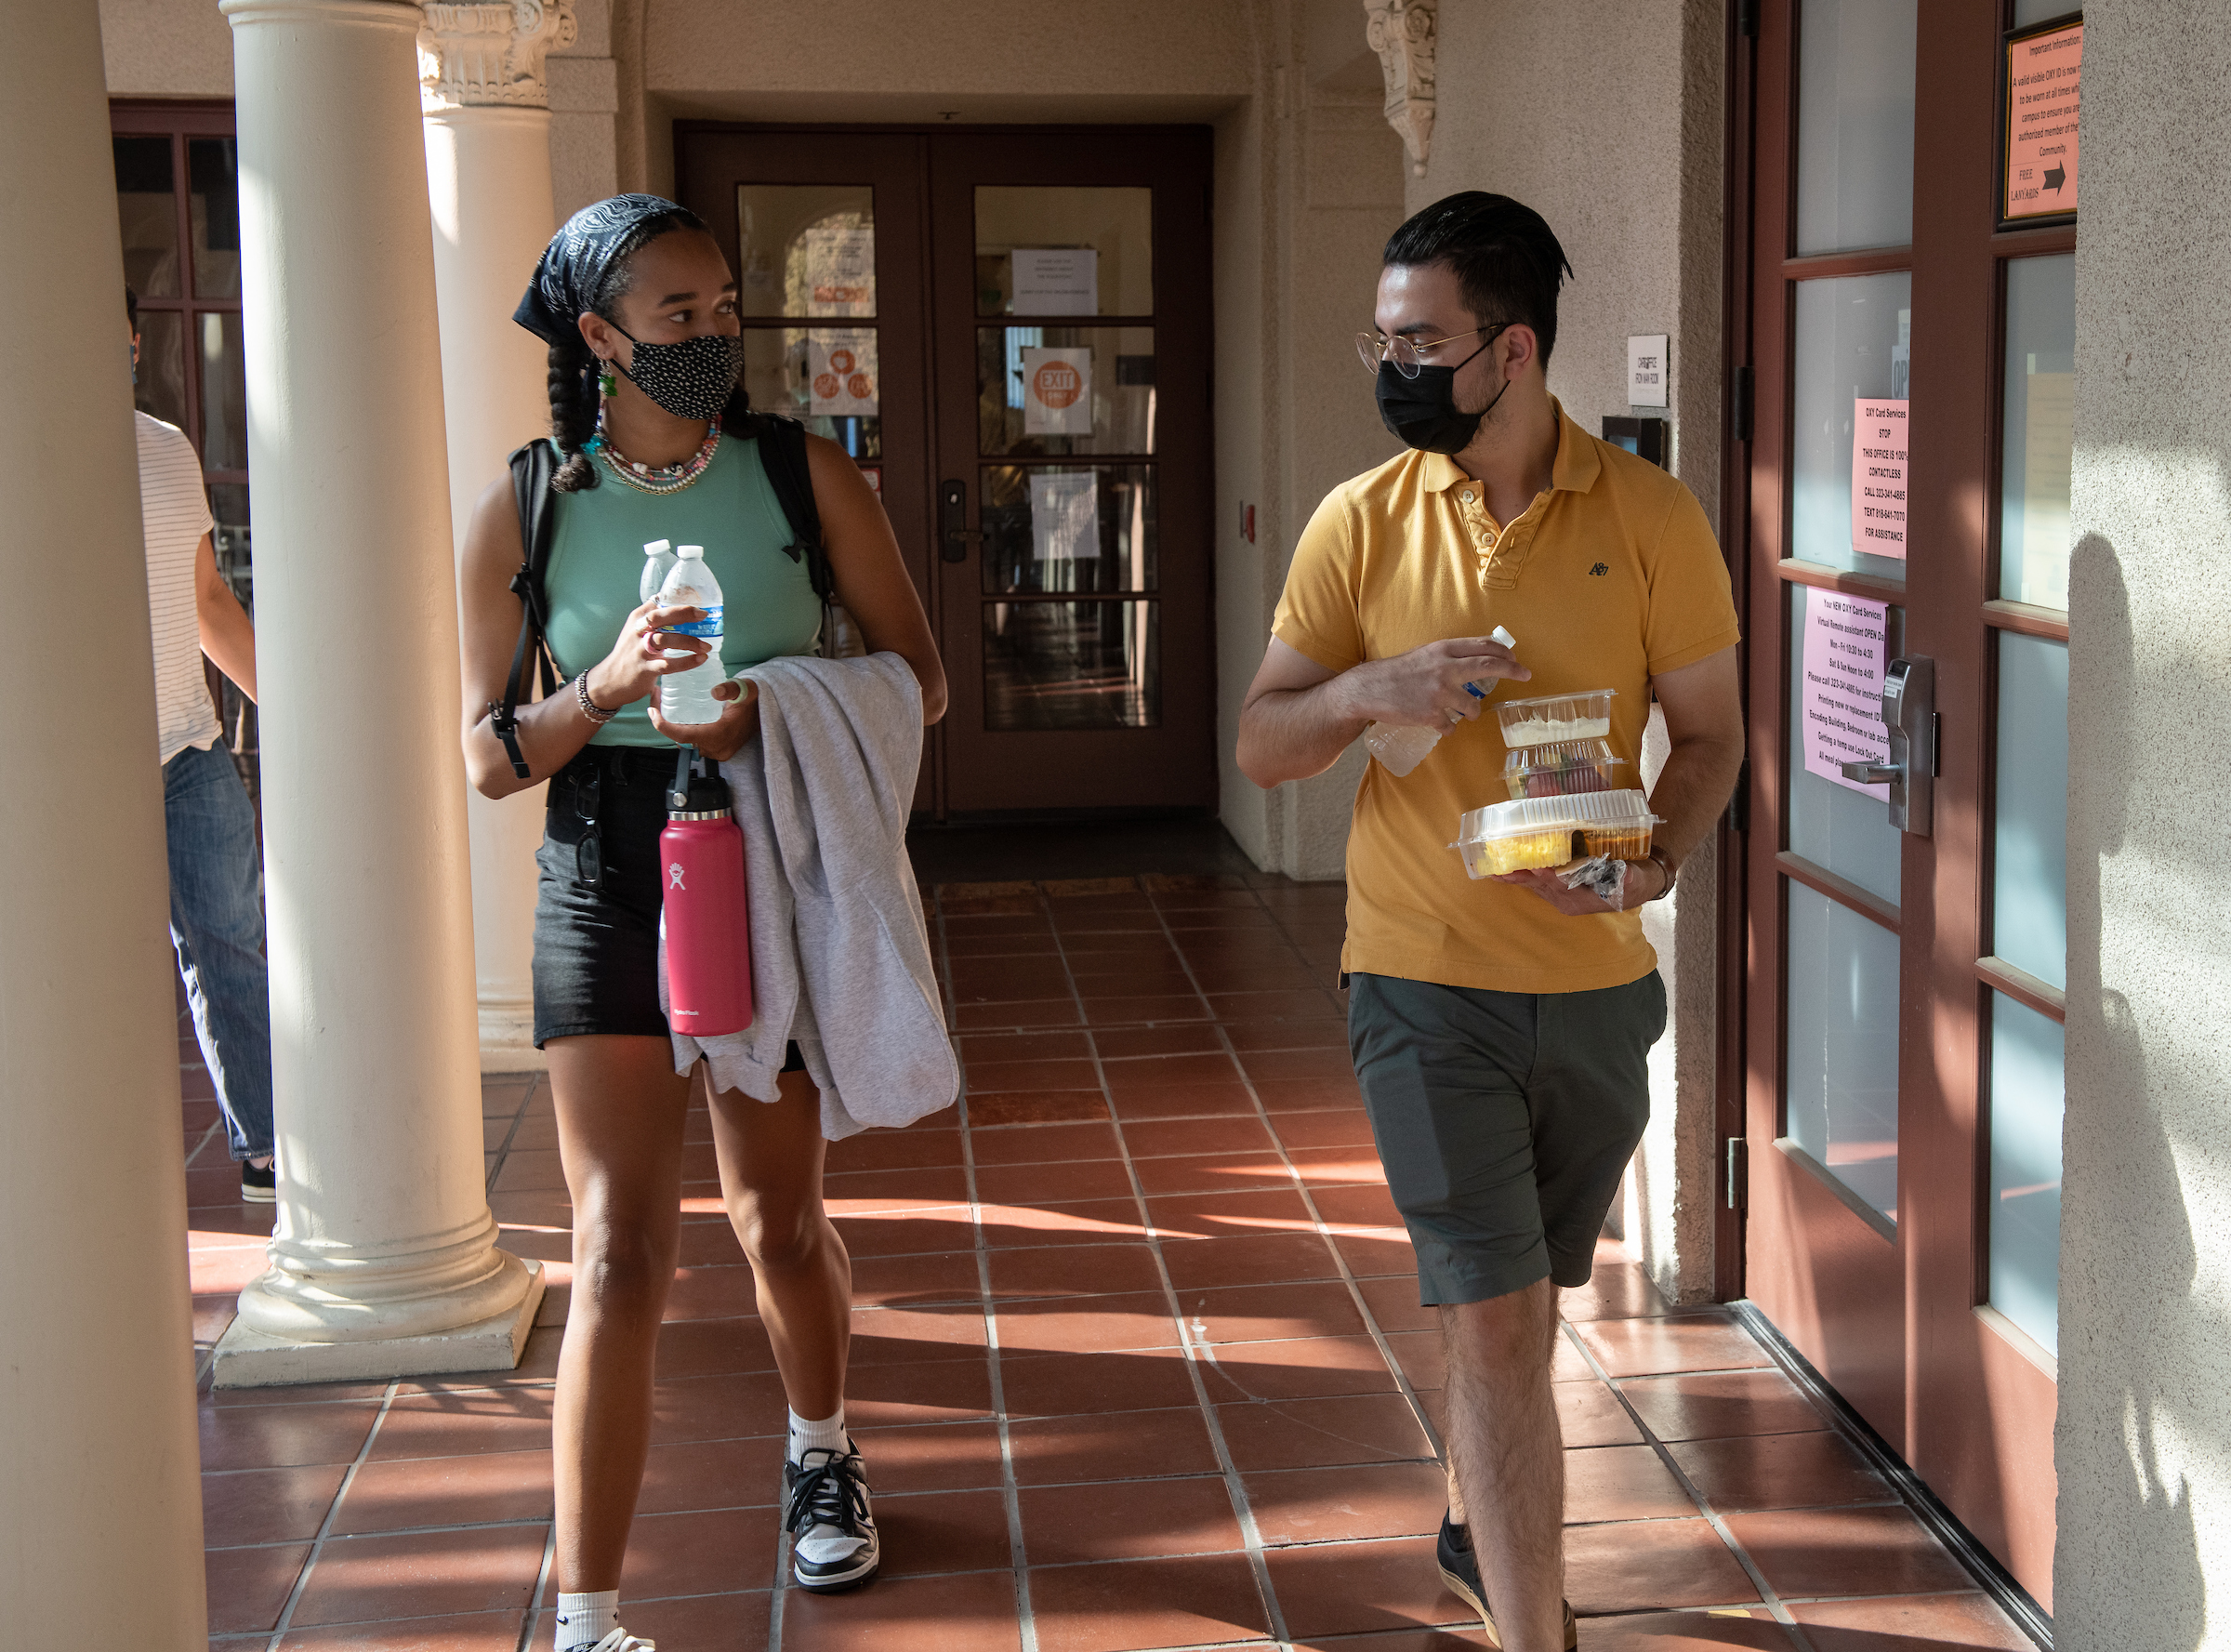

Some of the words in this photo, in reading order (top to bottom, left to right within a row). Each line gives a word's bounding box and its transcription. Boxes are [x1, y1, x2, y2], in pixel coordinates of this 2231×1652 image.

[2029, 42, 2053, 57] Important
[2053, 34, 2081, 50] Information:
[2013, 77, 2017, 87] A
[2017, 73, 2029, 86] valid
[2030, 71, 2045, 84] visible
[2045, 68, 2056, 81] OXY
[2056, 67, 2062, 78] ID
[2062, 66, 2066, 76] is
[2066, 65, 2077, 75] now
[2019, 95, 2026, 105] to
[2026, 93, 2032, 104] be
[2032, 92, 2045, 102] worn
[2045, 89, 2051, 99] at
[2057, 86, 2071, 97] times
[2022, 112, 2040, 124] campus
[2040, 110, 2046, 119] to
[2046, 107, 2063, 118] ensure
[2063, 105, 2073, 117] you
[2018, 126, 2044, 142] authorized
[2044, 125, 2065, 138] member
[2064, 122, 2071, 134] of
[2019, 168, 2033, 180] FREE
[2010, 187, 2040, 201] LANYARDS
[1042, 372, 1072, 388] EXIT
[1894, 360, 1909, 398] OP
[1875, 407, 1886, 417] Card
[1886, 408, 1907, 418] Services
[1879, 429, 1891, 438] STOP
[1863, 447, 1873, 457] THIS
[1874, 448, 1889, 459] OFFICE
[1889, 449, 1894, 460] IS
[1868, 467, 1901, 479] CONTACTLESS
[1864, 486, 1875, 496] CALL
[1864, 507, 1875, 518] TEXT
[1865, 527, 1874, 537] FOR
[1875, 528, 1903, 542] ASSISTANCE
[1824, 598, 1832, 608] Your
[1833, 601, 1842, 612] NEW
[1852, 605, 1863, 616] Card
[1863, 607, 1882, 621] Services
[1816, 615, 1830, 628] Virtual
[1830, 619, 1844, 632] Remote
[1844, 625, 1864, 637] assistant
[1864, 628, 1877, 640] OPEN
[1829, 639, 1838, 650] Mon
[1846, 644, 1857, 655] 10:30
[1857, 648, 1863, 656] to
[1863, 648, 1874, 659] 4:30
[1807, 670, 1822, 683] Please
[1822, 676, 1830, 686] call
[1828, 657, 1837, 668] Sat
[1837, 660, 1840, 669] &
[1847, 664, 1857, 676] Noon
[1857, 667, 1863, 677] to
[1863, 668, 1874, 680] 4:00
[1817, 693, 1834, 708] Printing
[1834, 701, 1844, 709] new
[1849, 705, 1873, 720] replacement
[1809, 709, 1828, 726] Encoding
[1847, 721, 1863, 736] Bedroom
[1868, 730, 1876, 741] lab
[1817, 731, 1833, 747] Getting
[1837, 738, 1847, 751] temp
[1847, 743, 1855, 753] use
[1855, 745, 1865, 757] Lock
[1865, 748, 1873, 760] Out
[1824, 754, 1834, 765] meal
